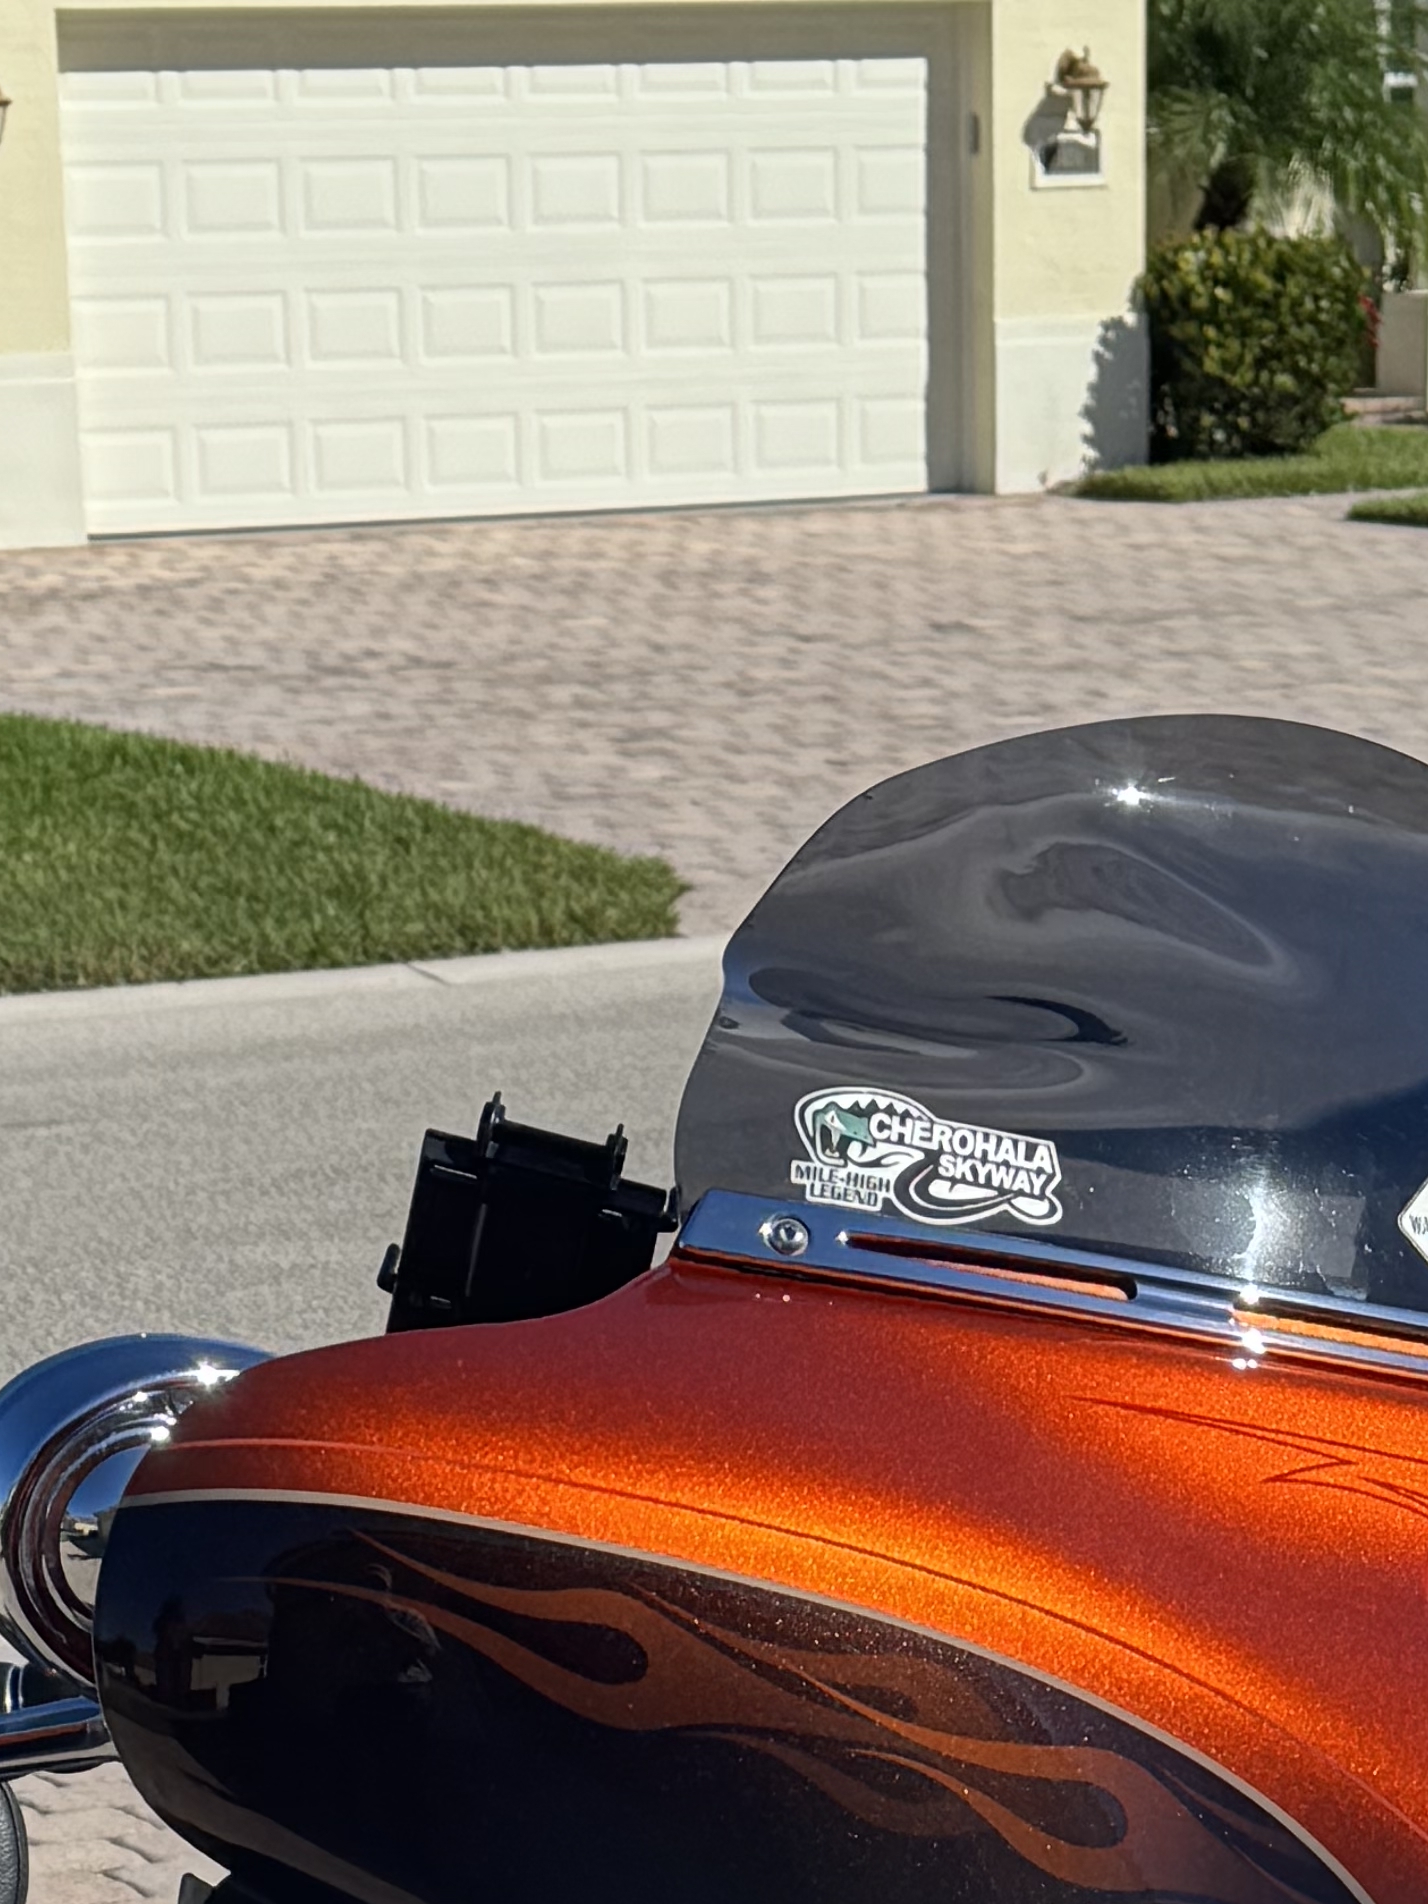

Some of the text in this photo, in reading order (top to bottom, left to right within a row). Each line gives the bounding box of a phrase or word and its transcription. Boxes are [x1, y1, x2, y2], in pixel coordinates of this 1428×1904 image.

[869, 1112, 1053, 1174] CHEROHALA
[795, 1163, 891, 1193] MILE-HIGH
[938, 1154, 1047, 1196] SKYWAY
[810, 1182, 880, 1207] LEGEND
